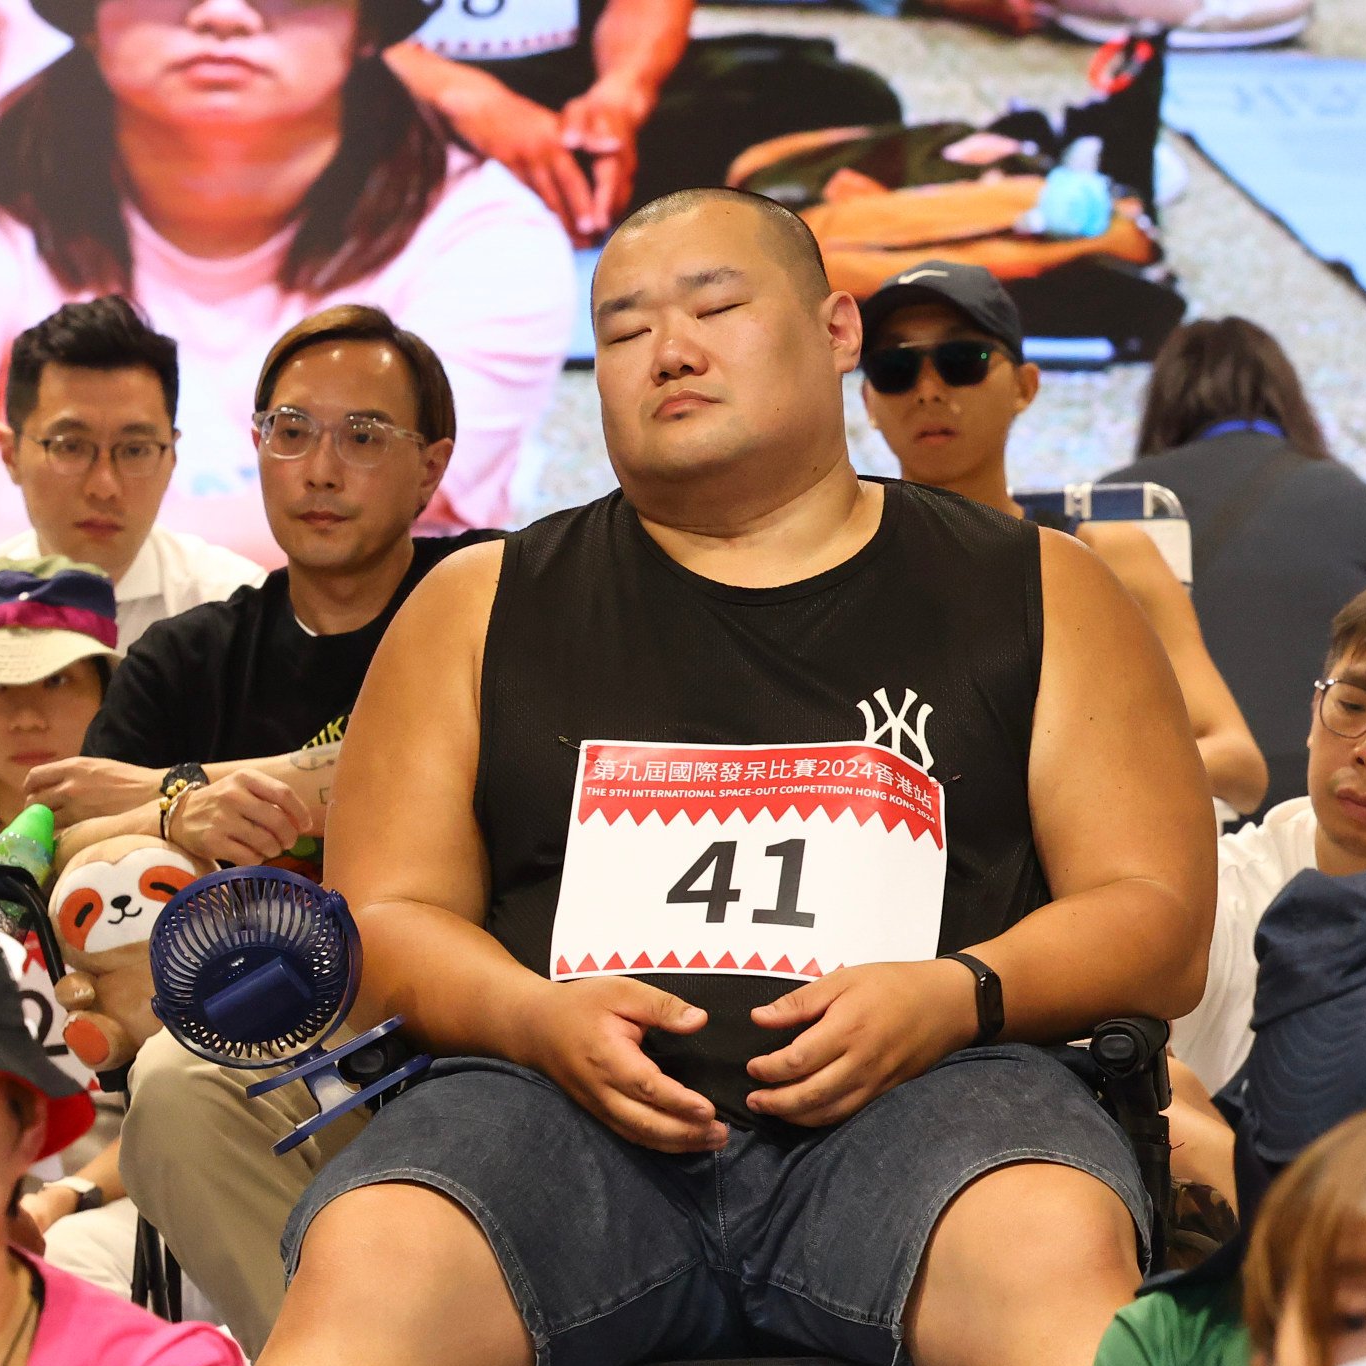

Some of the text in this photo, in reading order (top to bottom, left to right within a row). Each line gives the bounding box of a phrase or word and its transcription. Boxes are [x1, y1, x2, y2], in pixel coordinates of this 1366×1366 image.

[586, 785, 936, 824] THE 9TH INTERNATIONAL SPACE-OUT COMPETITION HONG KONG 2024
[592, 758, 932, 811] 第九屆國際發呆比賽2024香港站
[666, 838, 816, 928] 41
